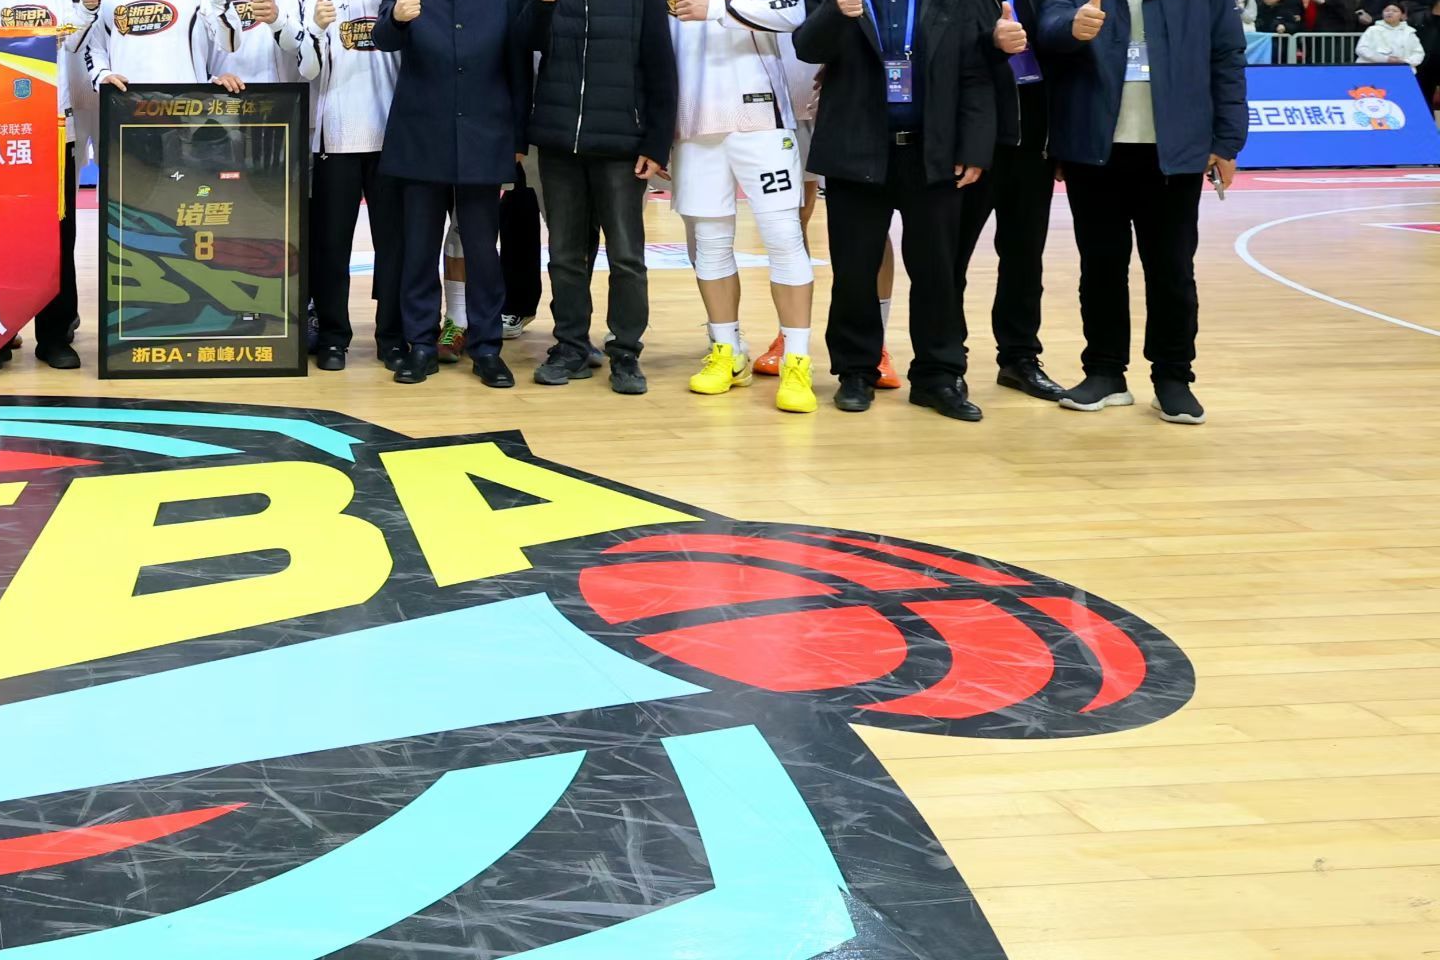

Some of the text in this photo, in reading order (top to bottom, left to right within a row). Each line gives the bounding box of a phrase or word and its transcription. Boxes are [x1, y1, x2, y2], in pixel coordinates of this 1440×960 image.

[128, 3, 165, 17] 浙BA
[131, 23, 162, 31] 2025
[1248, 105, 1347, 126] 自己的银行
[760, 169, 793, 194] 23
[176, 202, 234, 226] 诸暨
[194, 231, 214, 261] 8
[132, 346, 273, 363] 浙BA·巅峰八强
